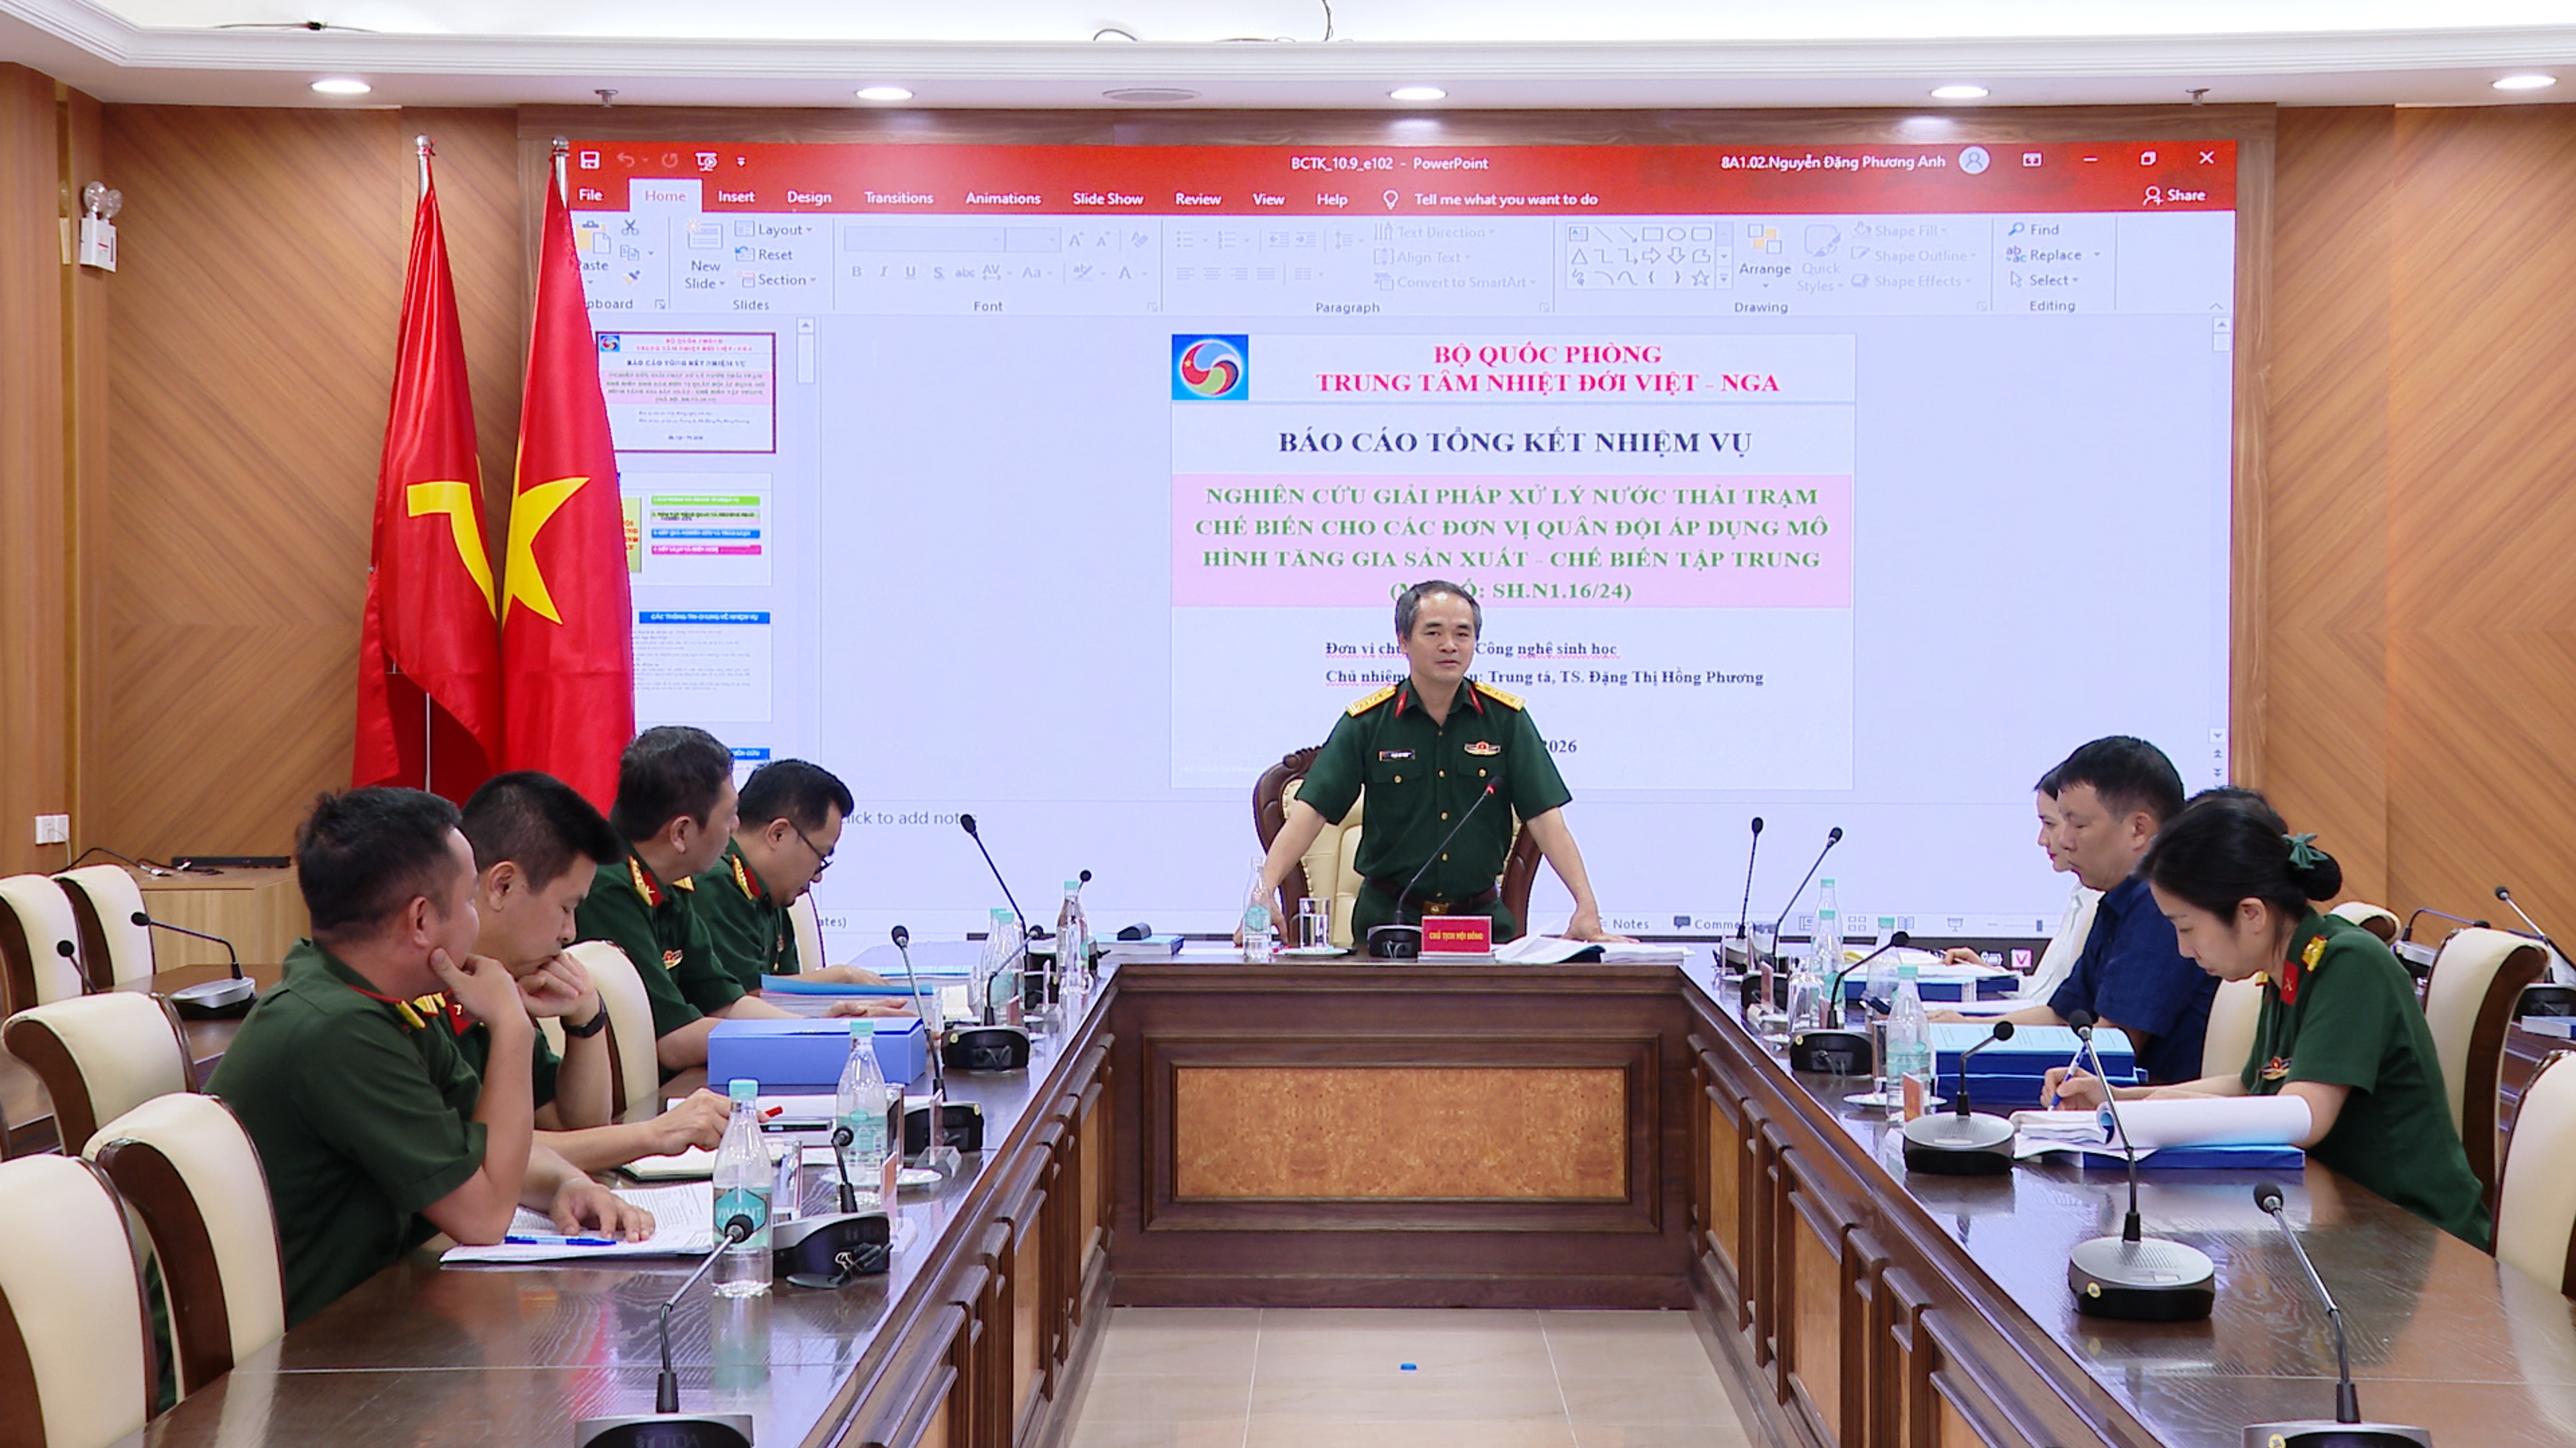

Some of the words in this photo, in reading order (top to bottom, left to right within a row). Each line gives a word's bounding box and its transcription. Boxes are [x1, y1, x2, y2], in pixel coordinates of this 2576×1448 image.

[1291, 157, 1393, 172] BCTK_10.9_e102
[1413, 156, 1489, 170] PowerPoint
[1721, 153, 1820, 171] 8A1.02.Nguyễn
[1823, 154, 1859, 171] Đặng
[1862, 155, 1914, 171] Phương
[1918, 155, 1946, 168] Anh
[579, 189, 603, 201] File
[644, 190, 687, 202] Home
[718, 190, 755, 203] Insert
[787, 191, 832, 206] Design
[864, 191, 934, 205] Transitions
[965, 192, 1042, 205] Animations
[1073, 192, 1105, 205] Slide
[1107, 192, 1144, 205] Show
[1175, 193, 1222, 206] Review
[1253, 193, 1285, 205] View
[1317, 193, 1348, 208] Help
[1414, 193, 1438, 205] Tell
[1440, 196, 1462, 205] me
[1464, 193, 1497, 205] what
[1499, 196, 1526, 209] you
[1528, 195, 1559, 205] want
[1562, 195, 1577, 205] to
[1579, 193, 1599, 205] do
[2167, 189, 2206, 201] Share
[759, 224, 803, 238] Layout
[1397, 226, 1424, 238] Text
[1427, 226, 1485, 238] Direction
[1875, 225, 1916, 238] Shape
[1919, 225, 1938, 236] Fill
[2030, 224, 2059, 236] Find
[759, 248, 793, 261] Reset
[1397, 251, 1433, 266] Align
[1436, 252, 1461, 263] Text
[1875, 251, 1916, 264] Shape
[1918, 250, 1967, 262] Outline
[2030, 249, 2083, 263] Replace
[579, 260, 609, 270] aste
[691, 260, 721, 272] New
[1739, 263, 1791, 277] Arrange
[1802, 262, 1841, 276] Quick
[685, 277, 717, 289] Slide
[759, 274, 807, 286] Section
[1397, 277, 1450, 289] Convert
[1452, 278, 1467, 289] to
[1469, 277, 1527, 289] SmartArt
[1875, 276, 1915, 289] Shape
[1919, 275, 1961, 287] Effects
[2030, 274, 2069, 287] Select
[1797, 280, 1834, 295] Styles
[587, 299, 633, 310] pboard
[733, 299, 770, 311] Slides
[974, 301, 1003, 312] Font
[1316, 302, 1380, 315] Paragraph
[1734, 301, 1789, 315] Drawing
[2030, 300, 2076, 313] Editing
[1434, 343, 1471, 367] BỘ
[1478, 341, 1557, 367] QUỐC
[1565, 341, 1662, 364] PHÒNG
[1316, 373, 1411, 392] TRUNG
[1417, 368, 1479, 392] TÂM
[1485, 370, 1571, 395] NHIỆT
[1577, 370, 1628, 391] ĐỚI
[1634, 370, 1699, 395] VIỆT
[1720, 374, 1781, 392] NGA
[1279, 426, 1343, 452] BÁO
[1351, 426, 1418, 452] CÁO
[1426, 425, 1516, 453] TỔNG
[1524, 426, 1587, 452] KẾT
[1595, 428, 1700, 458] NHIỆM
[1709, 432, 1753, 458] VỤ
[1206, 484, 1305, 505] NGHIÊN
[1311, 484, 1367, 505] CỨU
[1373, 484, 1429, 505] GIẢI
[1435, 484, 1502, 505] PHÁP
[1508, 484, 1548, 505] XỬ
[1552, 484, 1586, 505] LÝ
[1592, 484, 1667, 505] NƯỚC
[1673, 484, 1736, 505] THẢI
[1742, 488, 1818, 509] TRẠM
[1195, 515, 1248, 535] CHẾ
[1254, 515, 1314, 535] BIẾN
[1321, 520, 1377, 535] CHO
[1383, 516, 1436, 535] CÁC
[1442, 517, 1496, 535] ĐƠN
[1502, 520, 1530, 539] VỊ
[1537, 515, 1608, 539] QUÂN
[1615, 517, 1662, 539] ĐỘI
[1669, 515, 1701, 536] ÁP
[1707, 520, 1779, 539] DỤNG
[1786, 515, 1829, 536] MÔ
[1203, 547, 1268, 566] HÌNH
[1275, 547, 1344, 567] TĂNG
[1351, 551, 1397, 567] GIA
[1403, 546, 1453, 567] SẢN
[1459, 546, 1528, 567] XUẤT
[1549, 546, 1603, 567] CHẾ
[1609, 546, 1669, 567] BIẾN
[1675, 549, 1726, 571] TẬP
[1732, 551, 1821, 568] TRUNG
[1492, 582, 1632, 602] SH.N1.16/24)
[1326, 642, 1356, 654] Đơn
[1476, 642, 1514, 658] Công
[1556, 642, 1587, 655] sinh
[1591, 642, 1618, 658] học
[1326, 669, 1357, 683] Chủ
[1488, 670, 1534, 686] Trung
[1538, 670, 1556, 685] tá,
[1559, 670, 1585, 683] TS.
[1589, 670, 1628, 686] Đặng
[1631, 670, 1658, 686] Thị
[1662, 666, 1702, 686] Hồng
[1705, 670, 1764, 686] Phương
[877, 813, 893, 825] to
[899, 811, 929, 825] add
[934, 813, 977, 825] not
[1613, 919, 1650, 930] Notes
[1695, 919, 1740, 930] Comme
